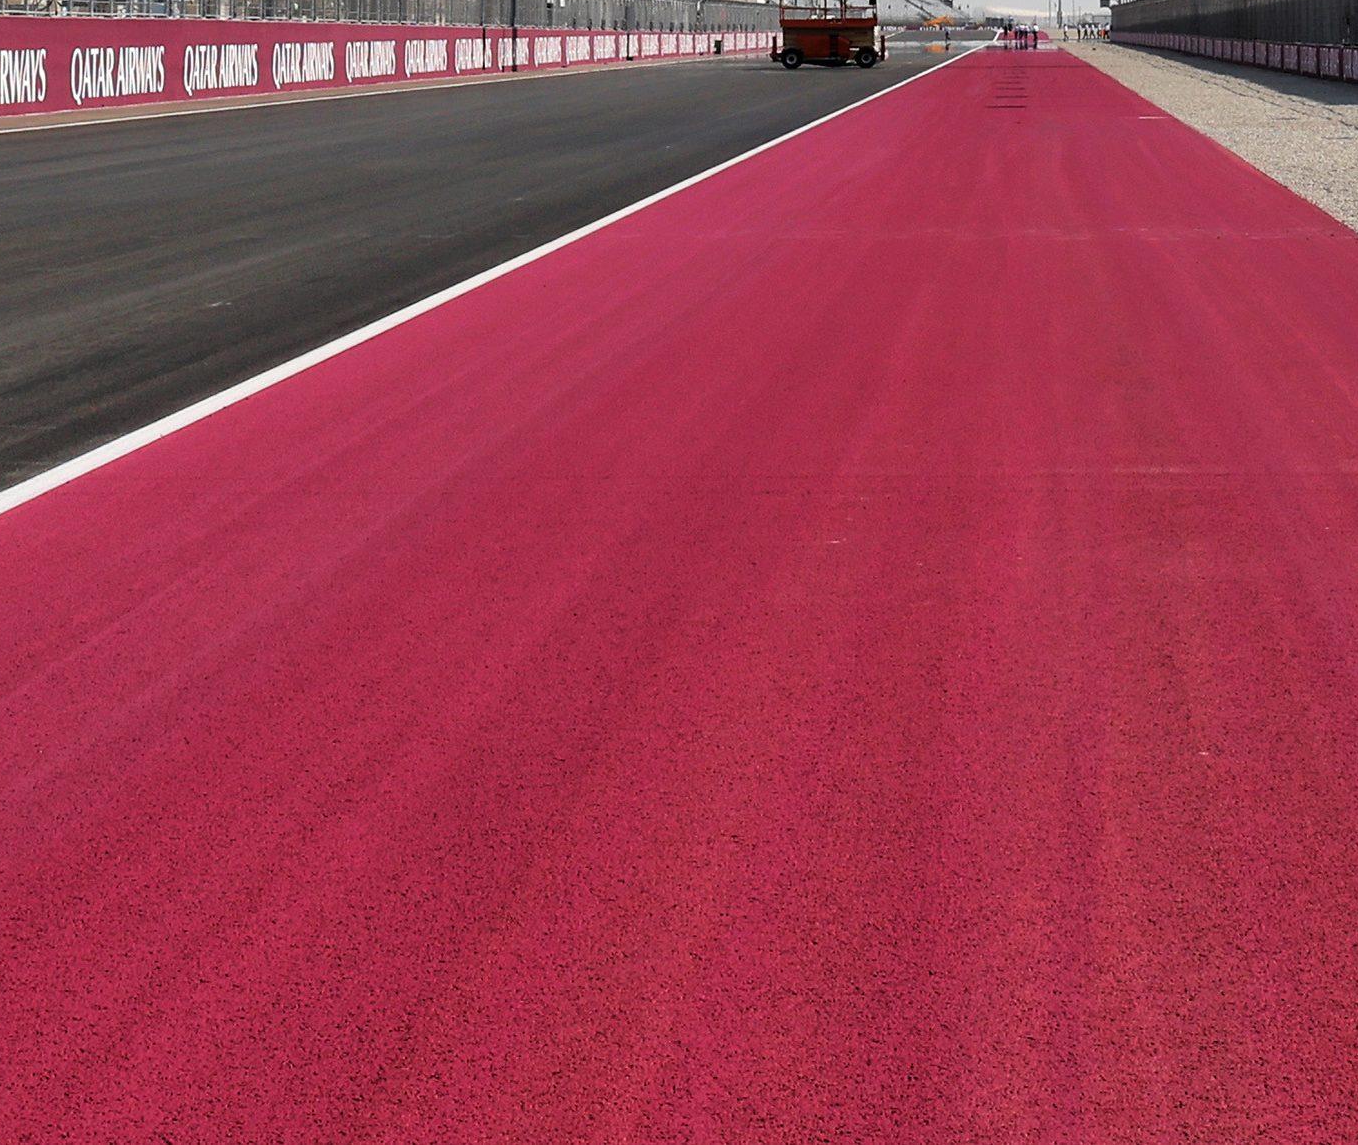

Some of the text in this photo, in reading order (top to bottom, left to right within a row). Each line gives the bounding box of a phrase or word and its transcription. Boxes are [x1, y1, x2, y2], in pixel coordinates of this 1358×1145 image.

[70, 45, 165, 105] QATAR AIRWAYS
[183, 43, 258, 96] QATAR AIRWAYS
[272, 42, 301, 89] QATAR
